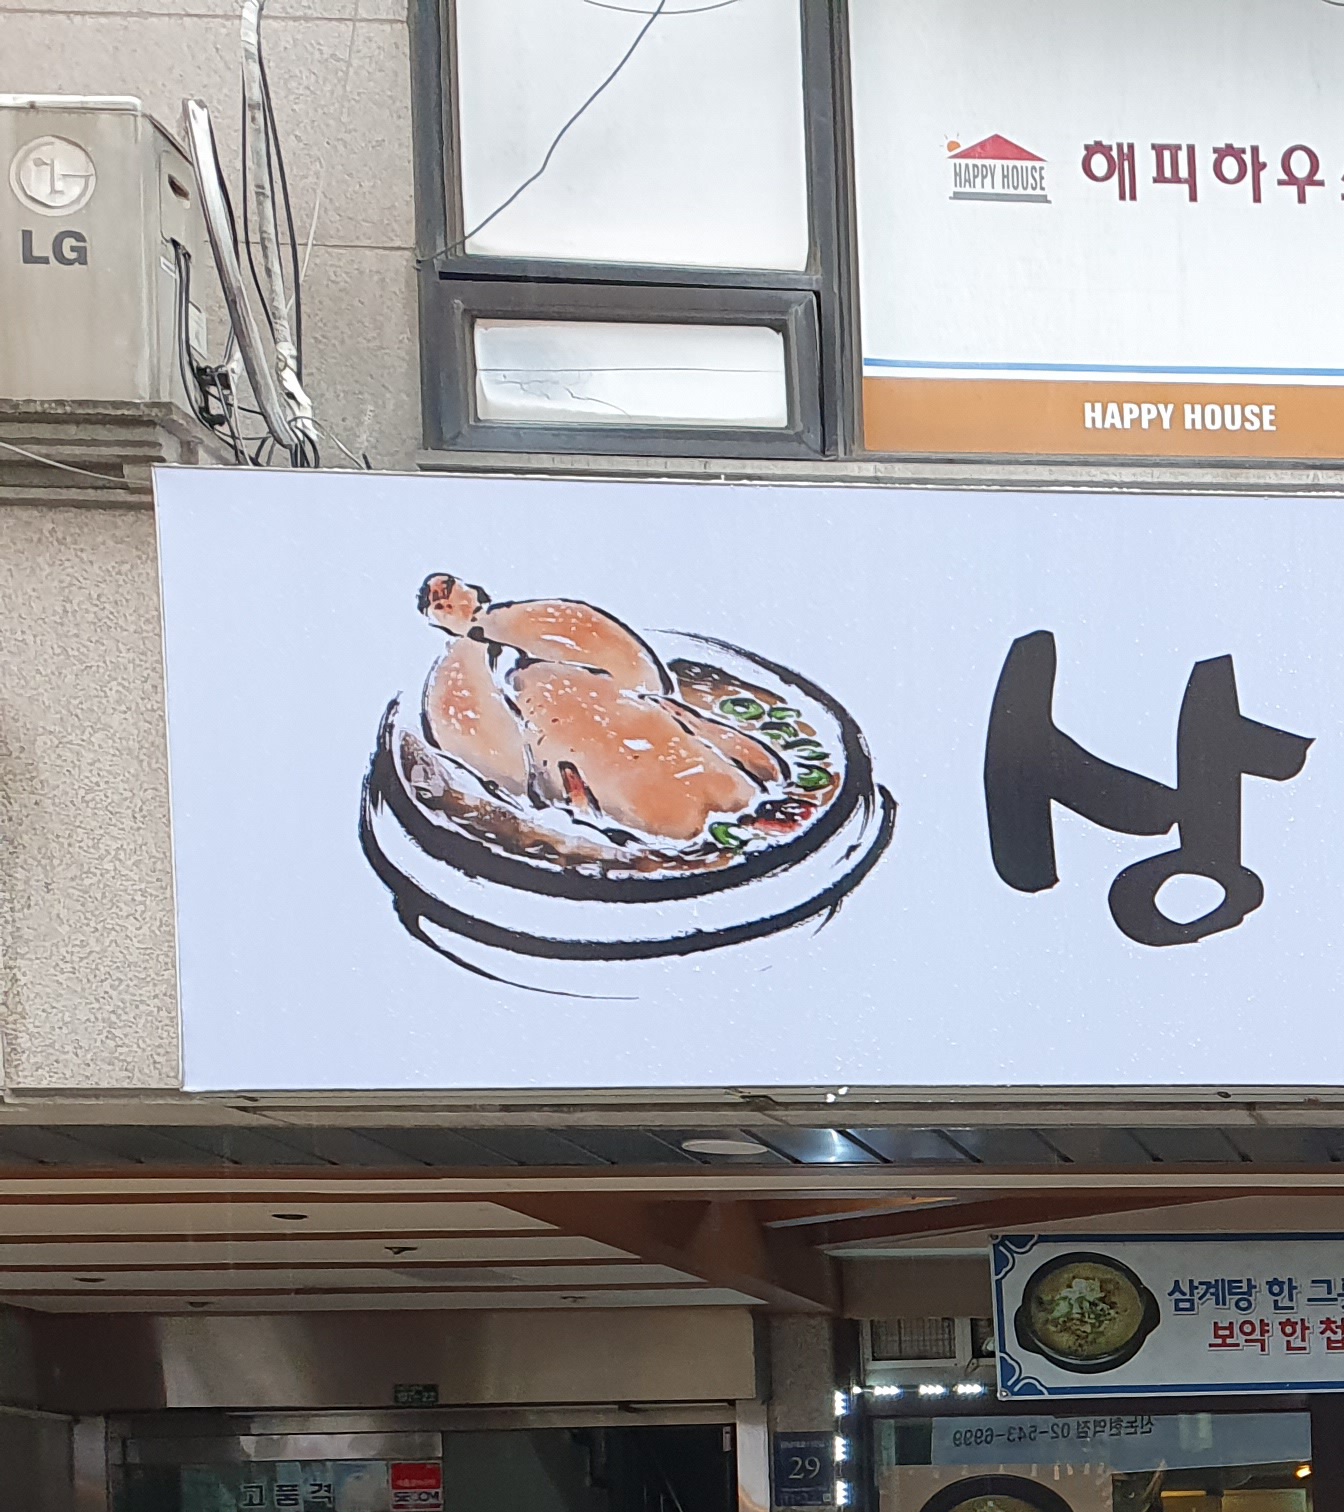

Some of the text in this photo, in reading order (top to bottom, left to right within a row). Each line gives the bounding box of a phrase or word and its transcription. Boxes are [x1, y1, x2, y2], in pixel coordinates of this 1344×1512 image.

[953, 162, 1046, 192] HAPPY HOUSE
[22, 229, 88, 266] LG
[1084, 401, 1277, 432] HAPPY HOUSE
[1167, 1277, 1258, 1316] 삼계탕
[1267, 1278, 1300, 1312] 한
[1208, 1318, 1270, 1354] 보약
[1279, 1317, 1312, 1352] 한
[788, 1456, 821, 1479] 29
